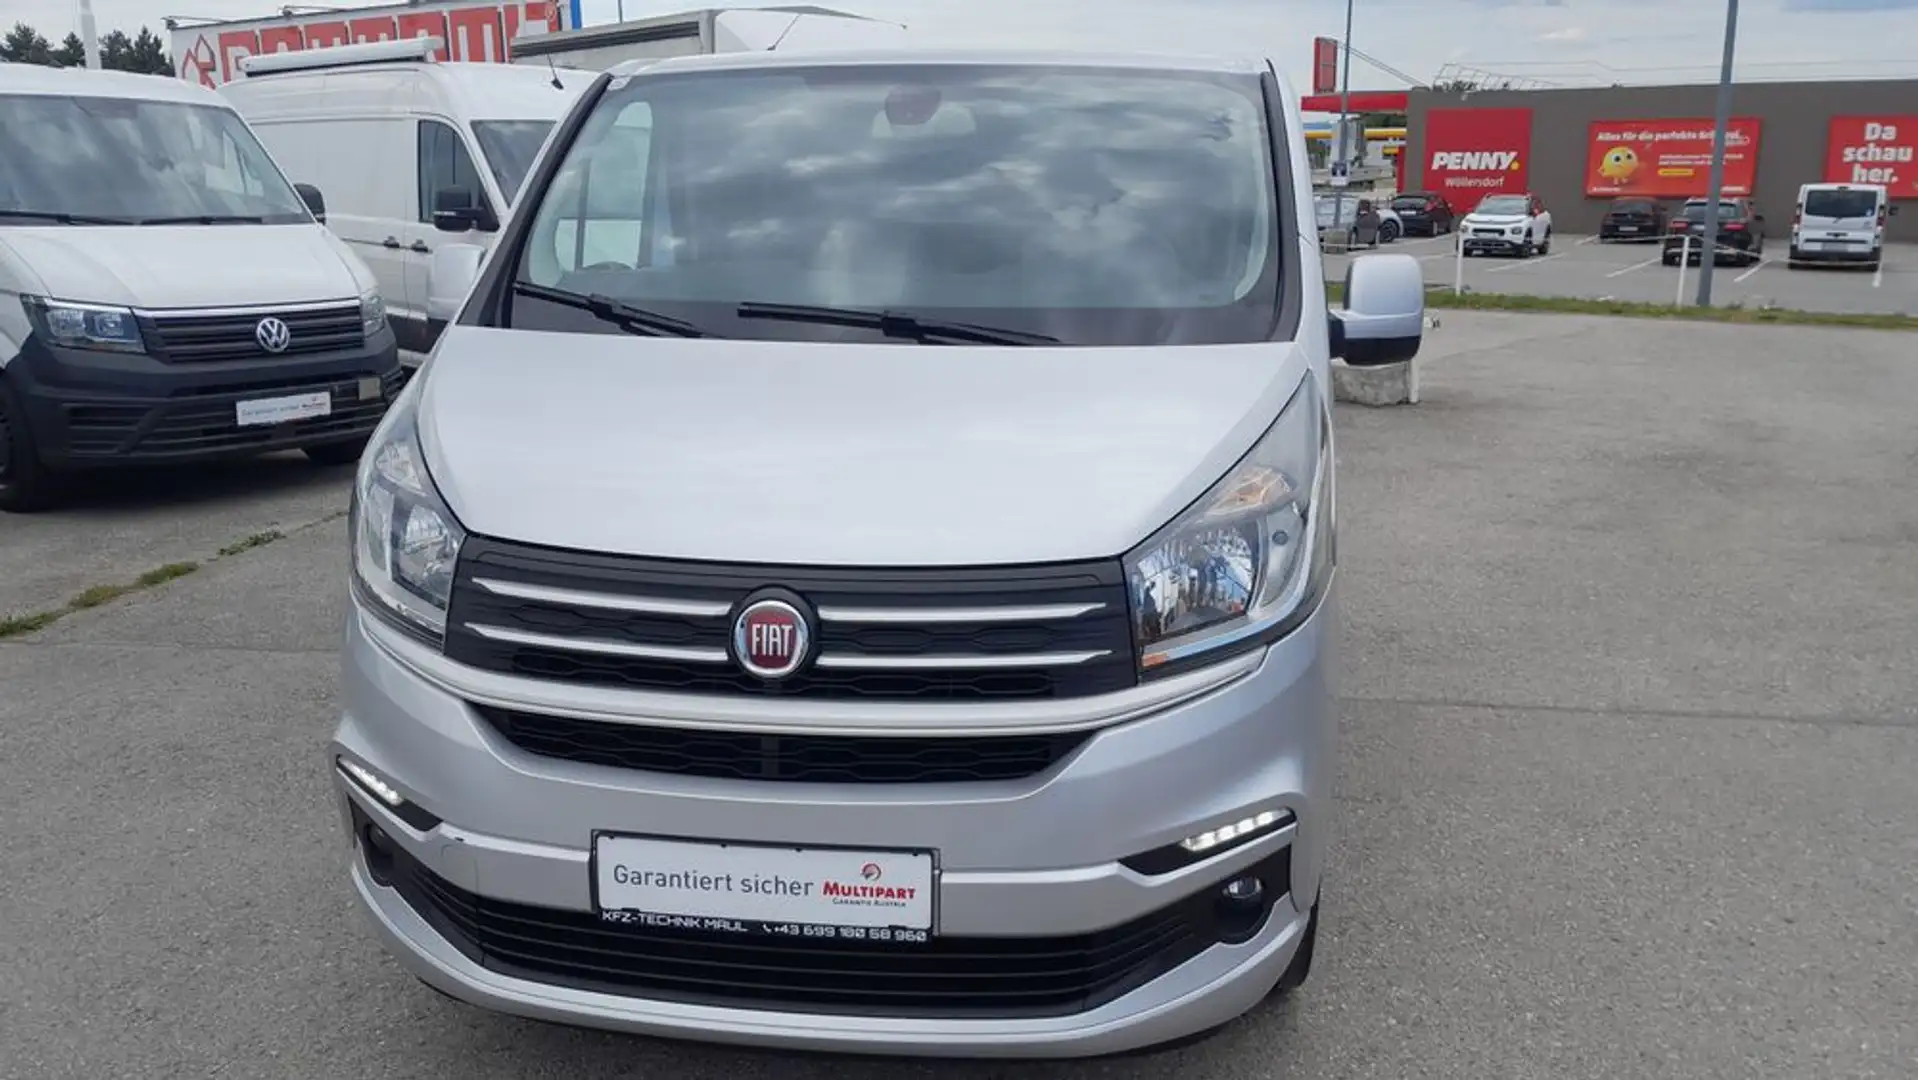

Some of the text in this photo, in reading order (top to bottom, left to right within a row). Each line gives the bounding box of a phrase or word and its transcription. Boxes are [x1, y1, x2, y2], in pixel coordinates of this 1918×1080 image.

[1864, 122, 1897, 141] Da
[1842, 142, 1913, 163] schau
[1852, 163, 1899, 183] her.
[751, 624, 793, 657] FIAT
[613, 864, 814, 896] Garantiert sicher
[822, 881, 916, 900] MULTIPART
[602, 911, 701, 928] KFZ-TECHNIK
[704, 918, 748, 932] MAUL
[803, 924, 835, 938] 699
